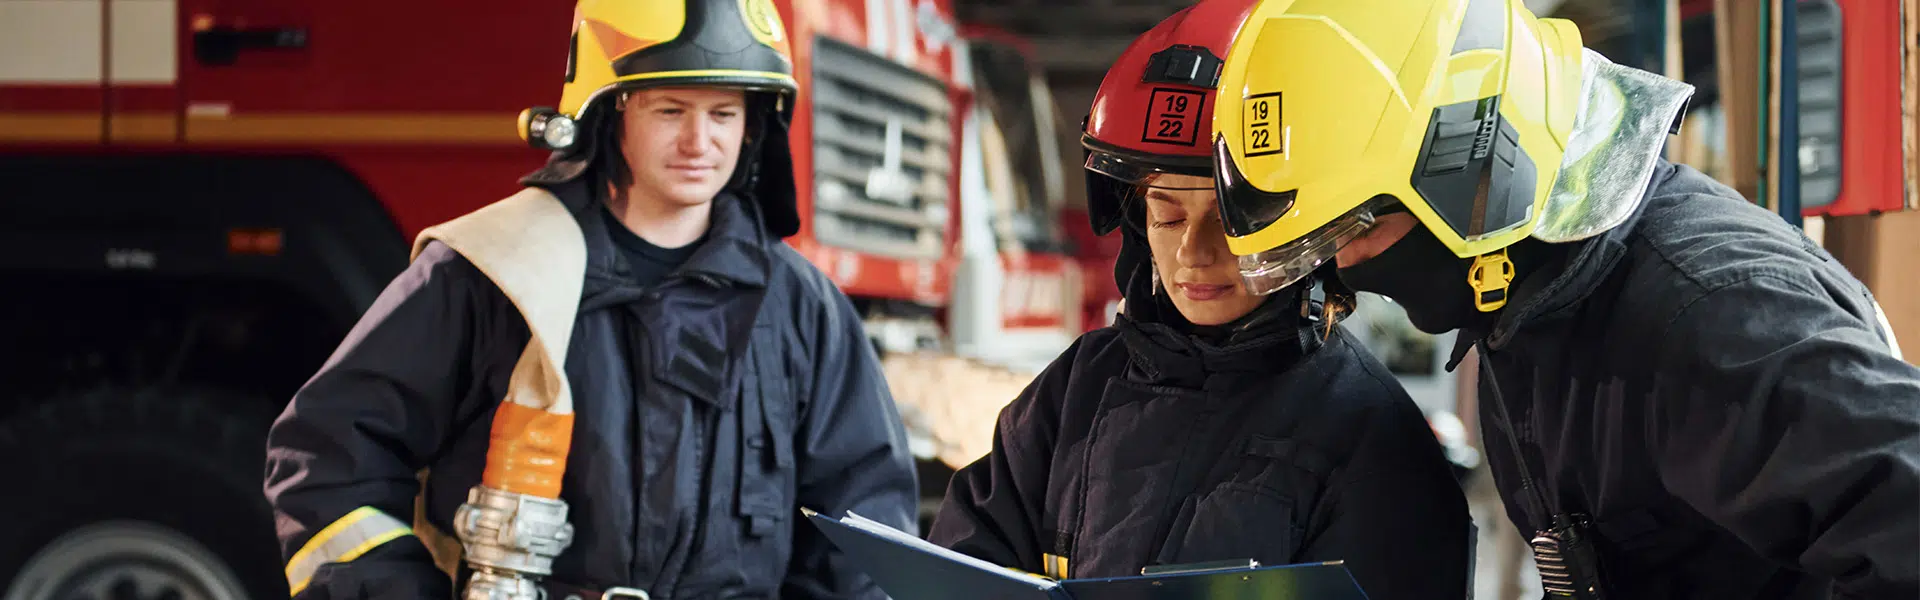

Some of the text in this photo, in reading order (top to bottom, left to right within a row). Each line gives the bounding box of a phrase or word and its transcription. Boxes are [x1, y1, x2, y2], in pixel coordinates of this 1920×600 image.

[1165, 95, 1188, 113] 19
[1252, 101, 1268, 120] 19
[1157, 120, 1183, 137] 22
[1251, 129, 1270, 149] 22
